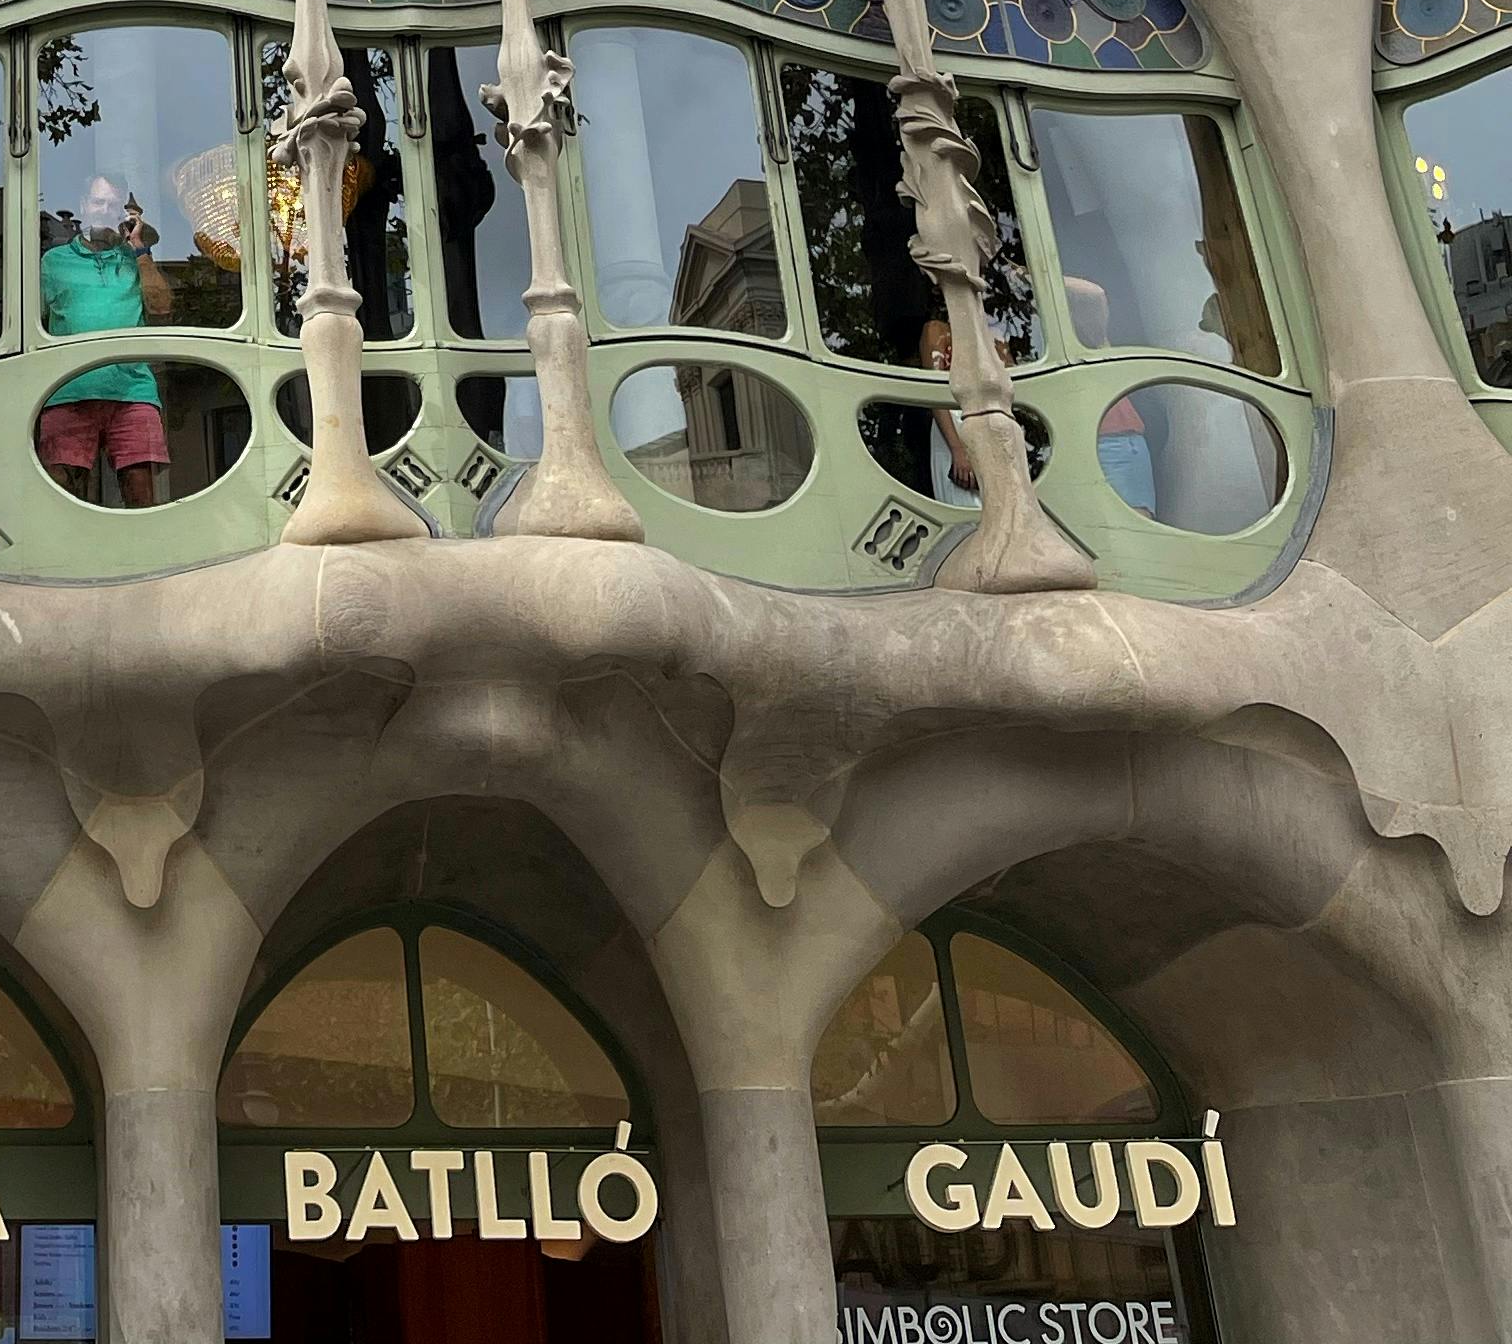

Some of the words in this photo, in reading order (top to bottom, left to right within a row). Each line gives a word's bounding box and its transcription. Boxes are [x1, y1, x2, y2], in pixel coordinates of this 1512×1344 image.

[284, 1120, 659, 1243] BATLLÓ
[904, 1109, 1237, 1233] GAUDÍ
[836, 1303, 1031, 1344] IMBOLIC
[1039, 1301, 1179, 1344] STORE
